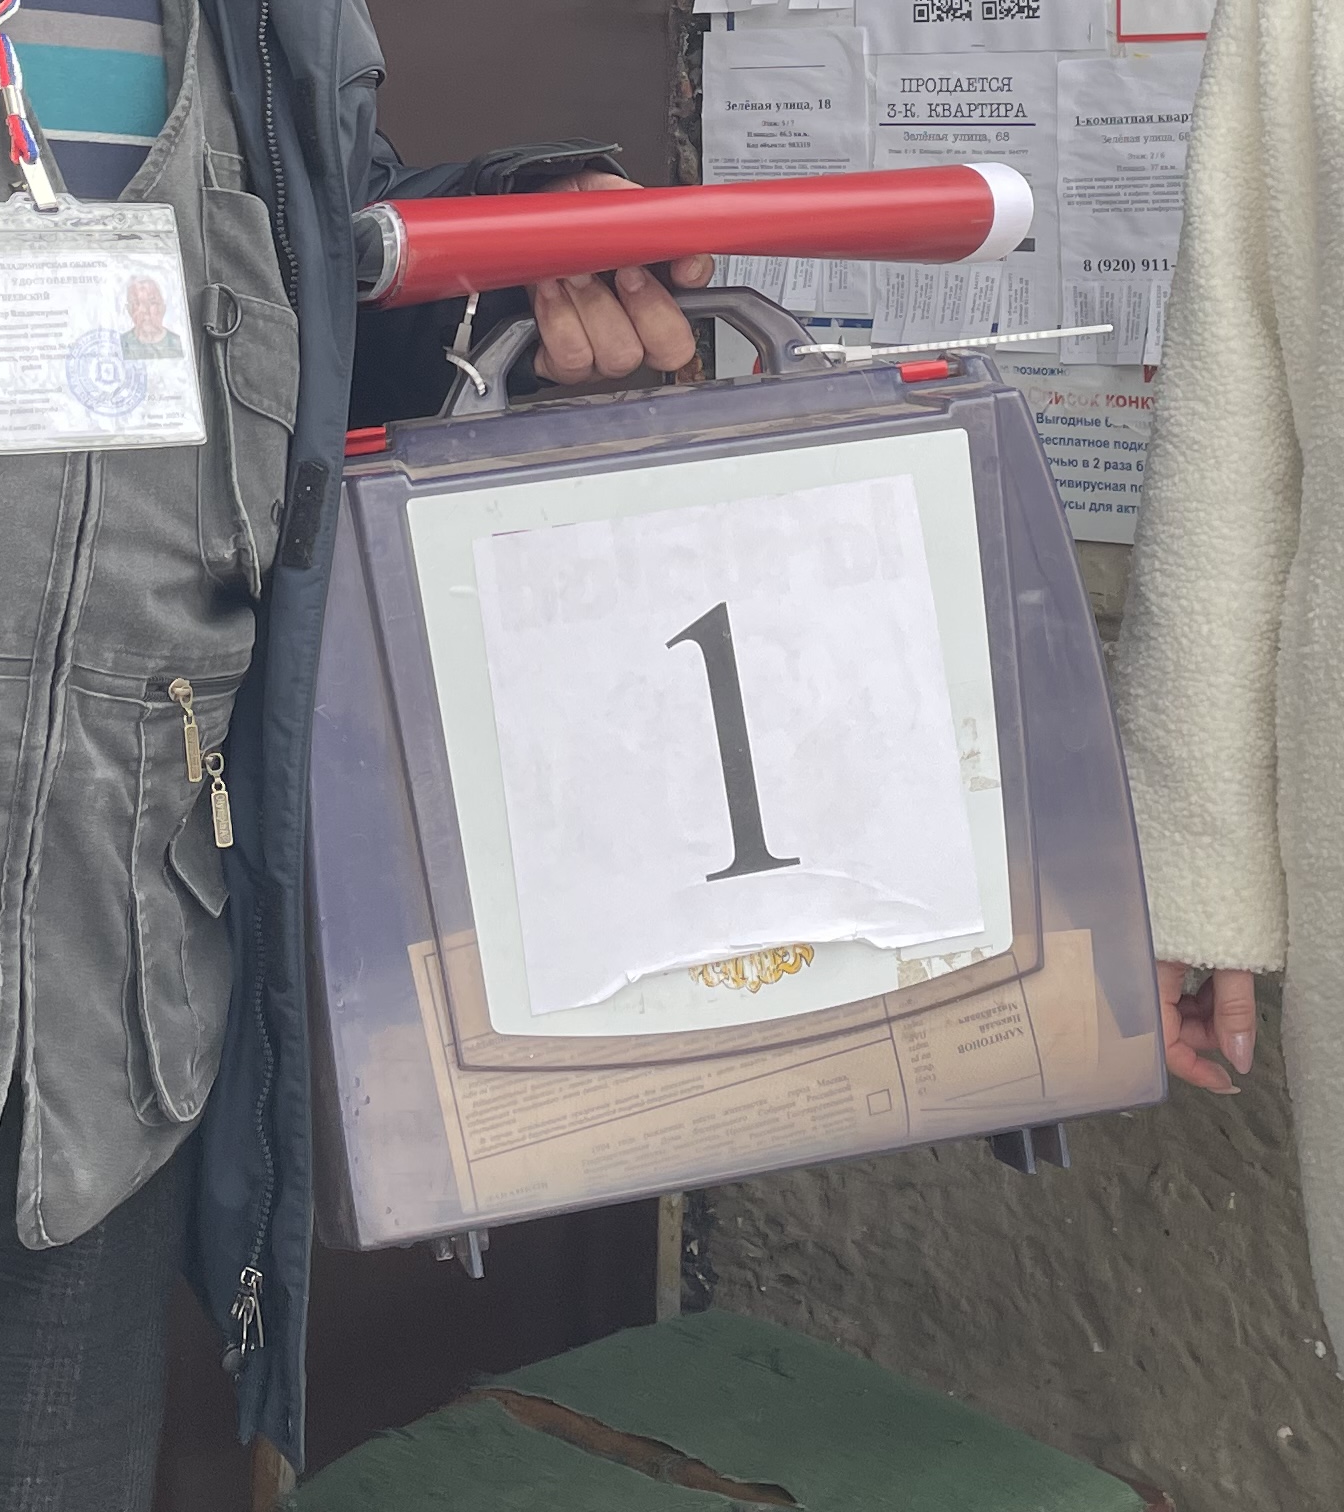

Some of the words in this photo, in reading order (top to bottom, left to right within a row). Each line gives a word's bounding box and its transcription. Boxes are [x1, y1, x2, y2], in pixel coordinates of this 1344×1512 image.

[900, 76, 1013, 96] ПРОДАЕТСЯ
[725, 99, 772, 112] Зелёная
[775, 100, 814, 113] улица,
[817, 99, 832, 110] 18
[887, 103, 920, 118] 3-К.
[927, 103, 1028, 118] КВАРТИРА
[1075, 113, 1154, 128] 1-комнатная
[903, 130, 948, 143] Зелёная
[952, 131, 992, 144] улица,
[1101, 134, 1140, 144] Зелёная
[1083, 259, 1092, 272] 8
[1097, 258, 1136, 274] (920)
[1036, 412, 1101, 429] Выгодные
[1082, 460, 1089, 468] в
[1093, 457, 1100, 469] 2
[1104, 460, 1132, 472] раза
[1089, 501, 1113, 513] для
[664, 601, 801, 882] 1
[957, 1027, 1024, 1054] ХАРИТОНОВ
